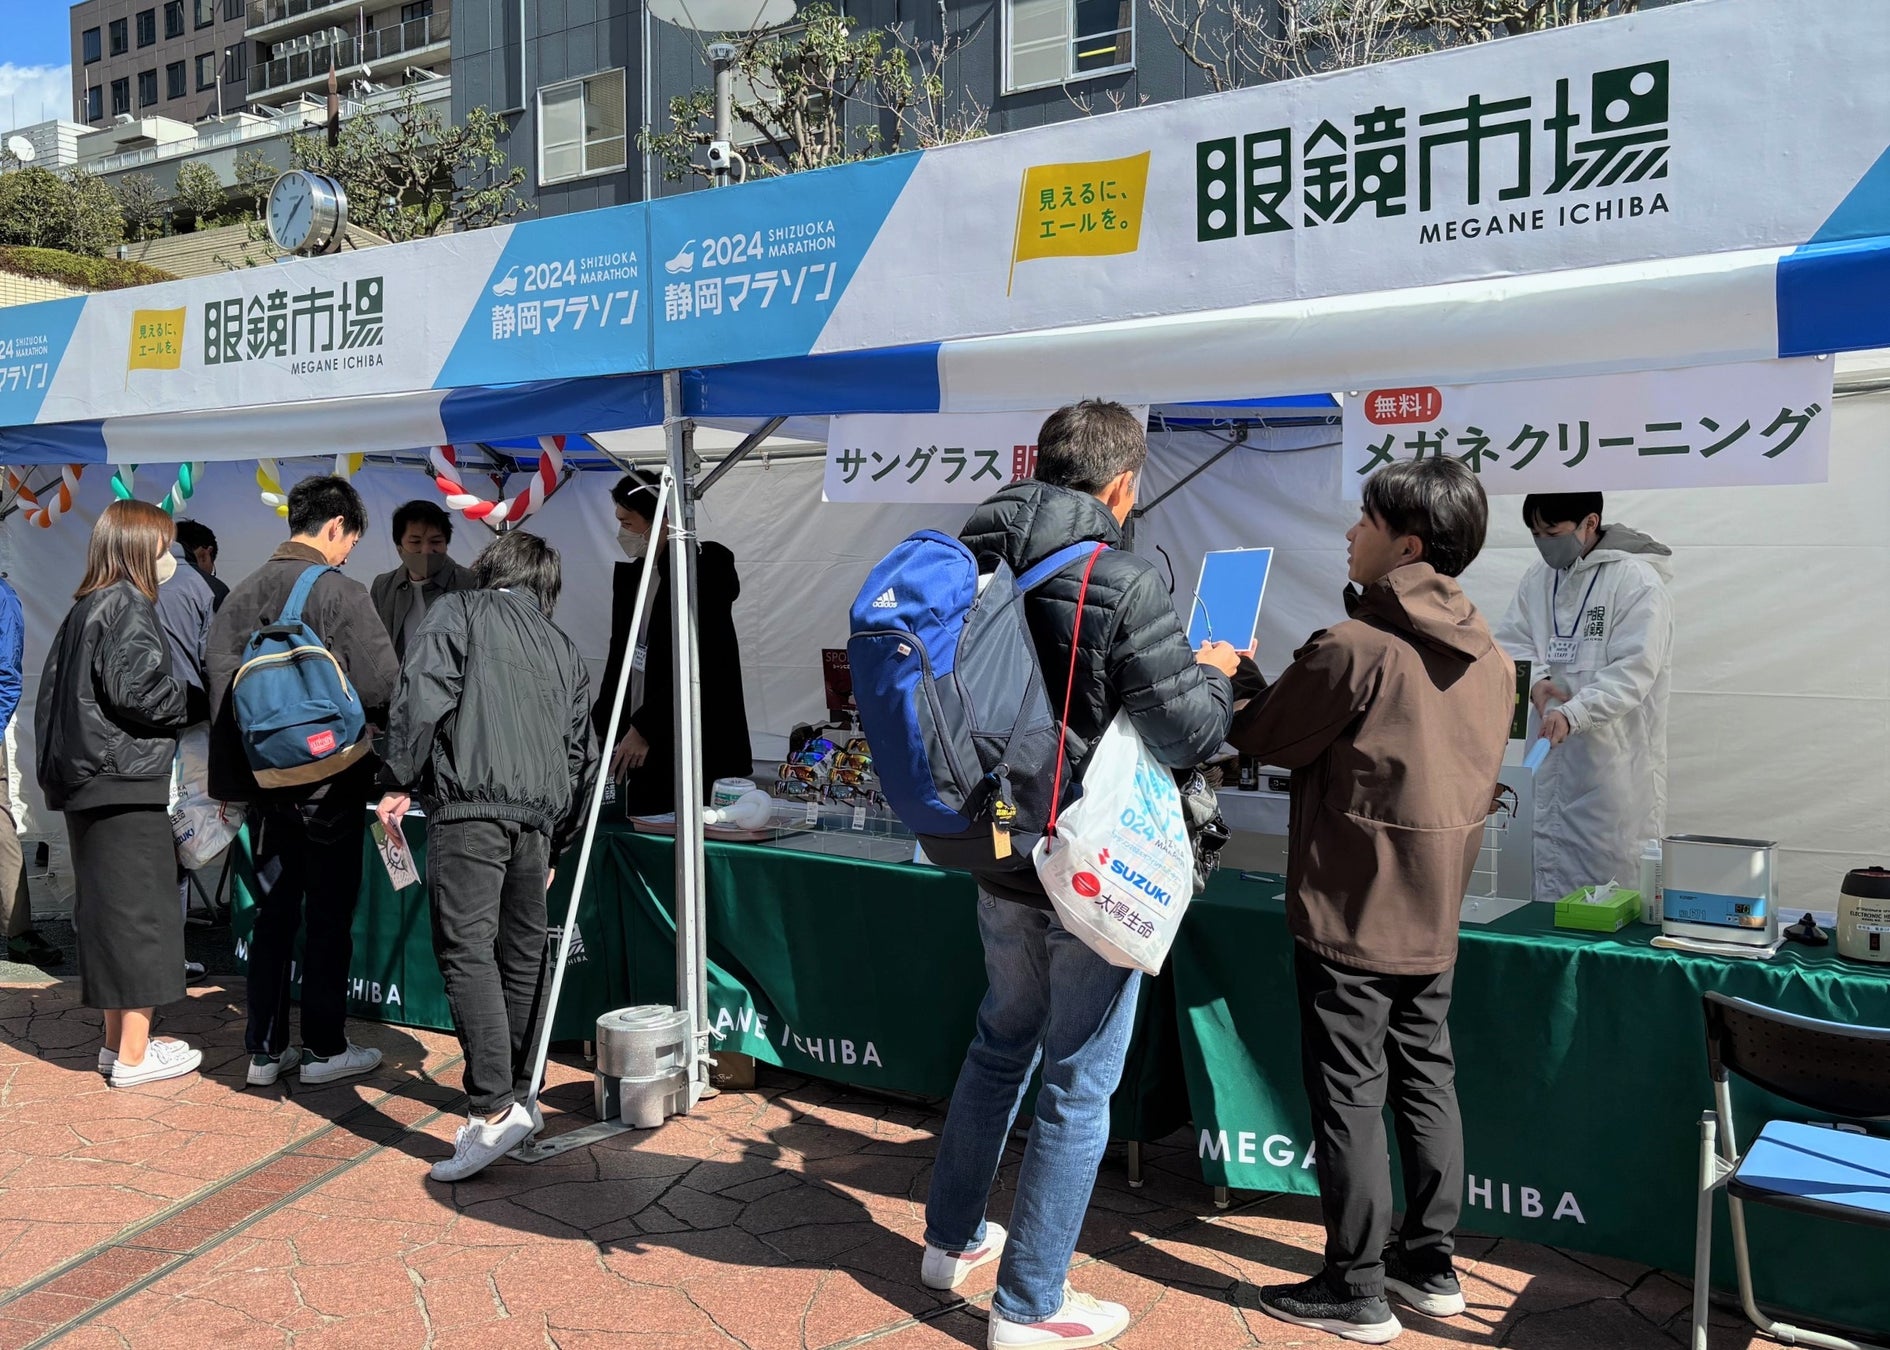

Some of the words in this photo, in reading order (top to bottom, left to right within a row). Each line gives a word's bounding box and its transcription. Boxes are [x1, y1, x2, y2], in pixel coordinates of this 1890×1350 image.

[1196, 59, 1670, 243] 眼鏡市場
[1039, 180, 1128, 212] 見えるに、
[767, 220, 835, 242] SHIZUOKA
[1039, 208, 1128, 239] エールを。
[1418, 208, 1544, 246] MEGANE
[1559, 192, 1670, 227] ICHIBA
[580, 251, 637, 269] SHIZUOKA
[701, 231, 764, 268] 2024
[767, 235, 836, 258] MARATHON
[523, 259, 577, 292] 2024
[579, 266, 638, 284] MARATHON
[664, 261, 837, 322] 静岡マラソン
[204, 276, 384, 365] 眼鏡市場
[491, 289, 638, 340] 静岡マラソン
[15, 335, 48, 348] SHIZUOKA
[139, 322, 177, 340] 見えるに、
[15, 345, 48, 357] MARATHON
[139, 340, 177, 357] エールを。
[291, 358, 338, 375] MEGANE
[343, 354, 384, 370] ICHIBA
[835, 445, 1003, 485] サングラス
[872, 600, 898, 609] adidas
[825, 651, 847, 663] SPO
[175, 828, 196, 847] ZUKI
[1120, 807, 1155, 842] 024
[1110, 859, 1172, 907] SUZUKI
[1095, 893, 1156, 939] 太陽生命
[567, 955, 589, 966] HIBA
[347, 977, 402, 1006] HIBA
[715, 1006, 769, 1040] ANE
[781, 1023, 883, 1068] ICHIBA
[1468, 1174, 1586, 1225] HIBA
